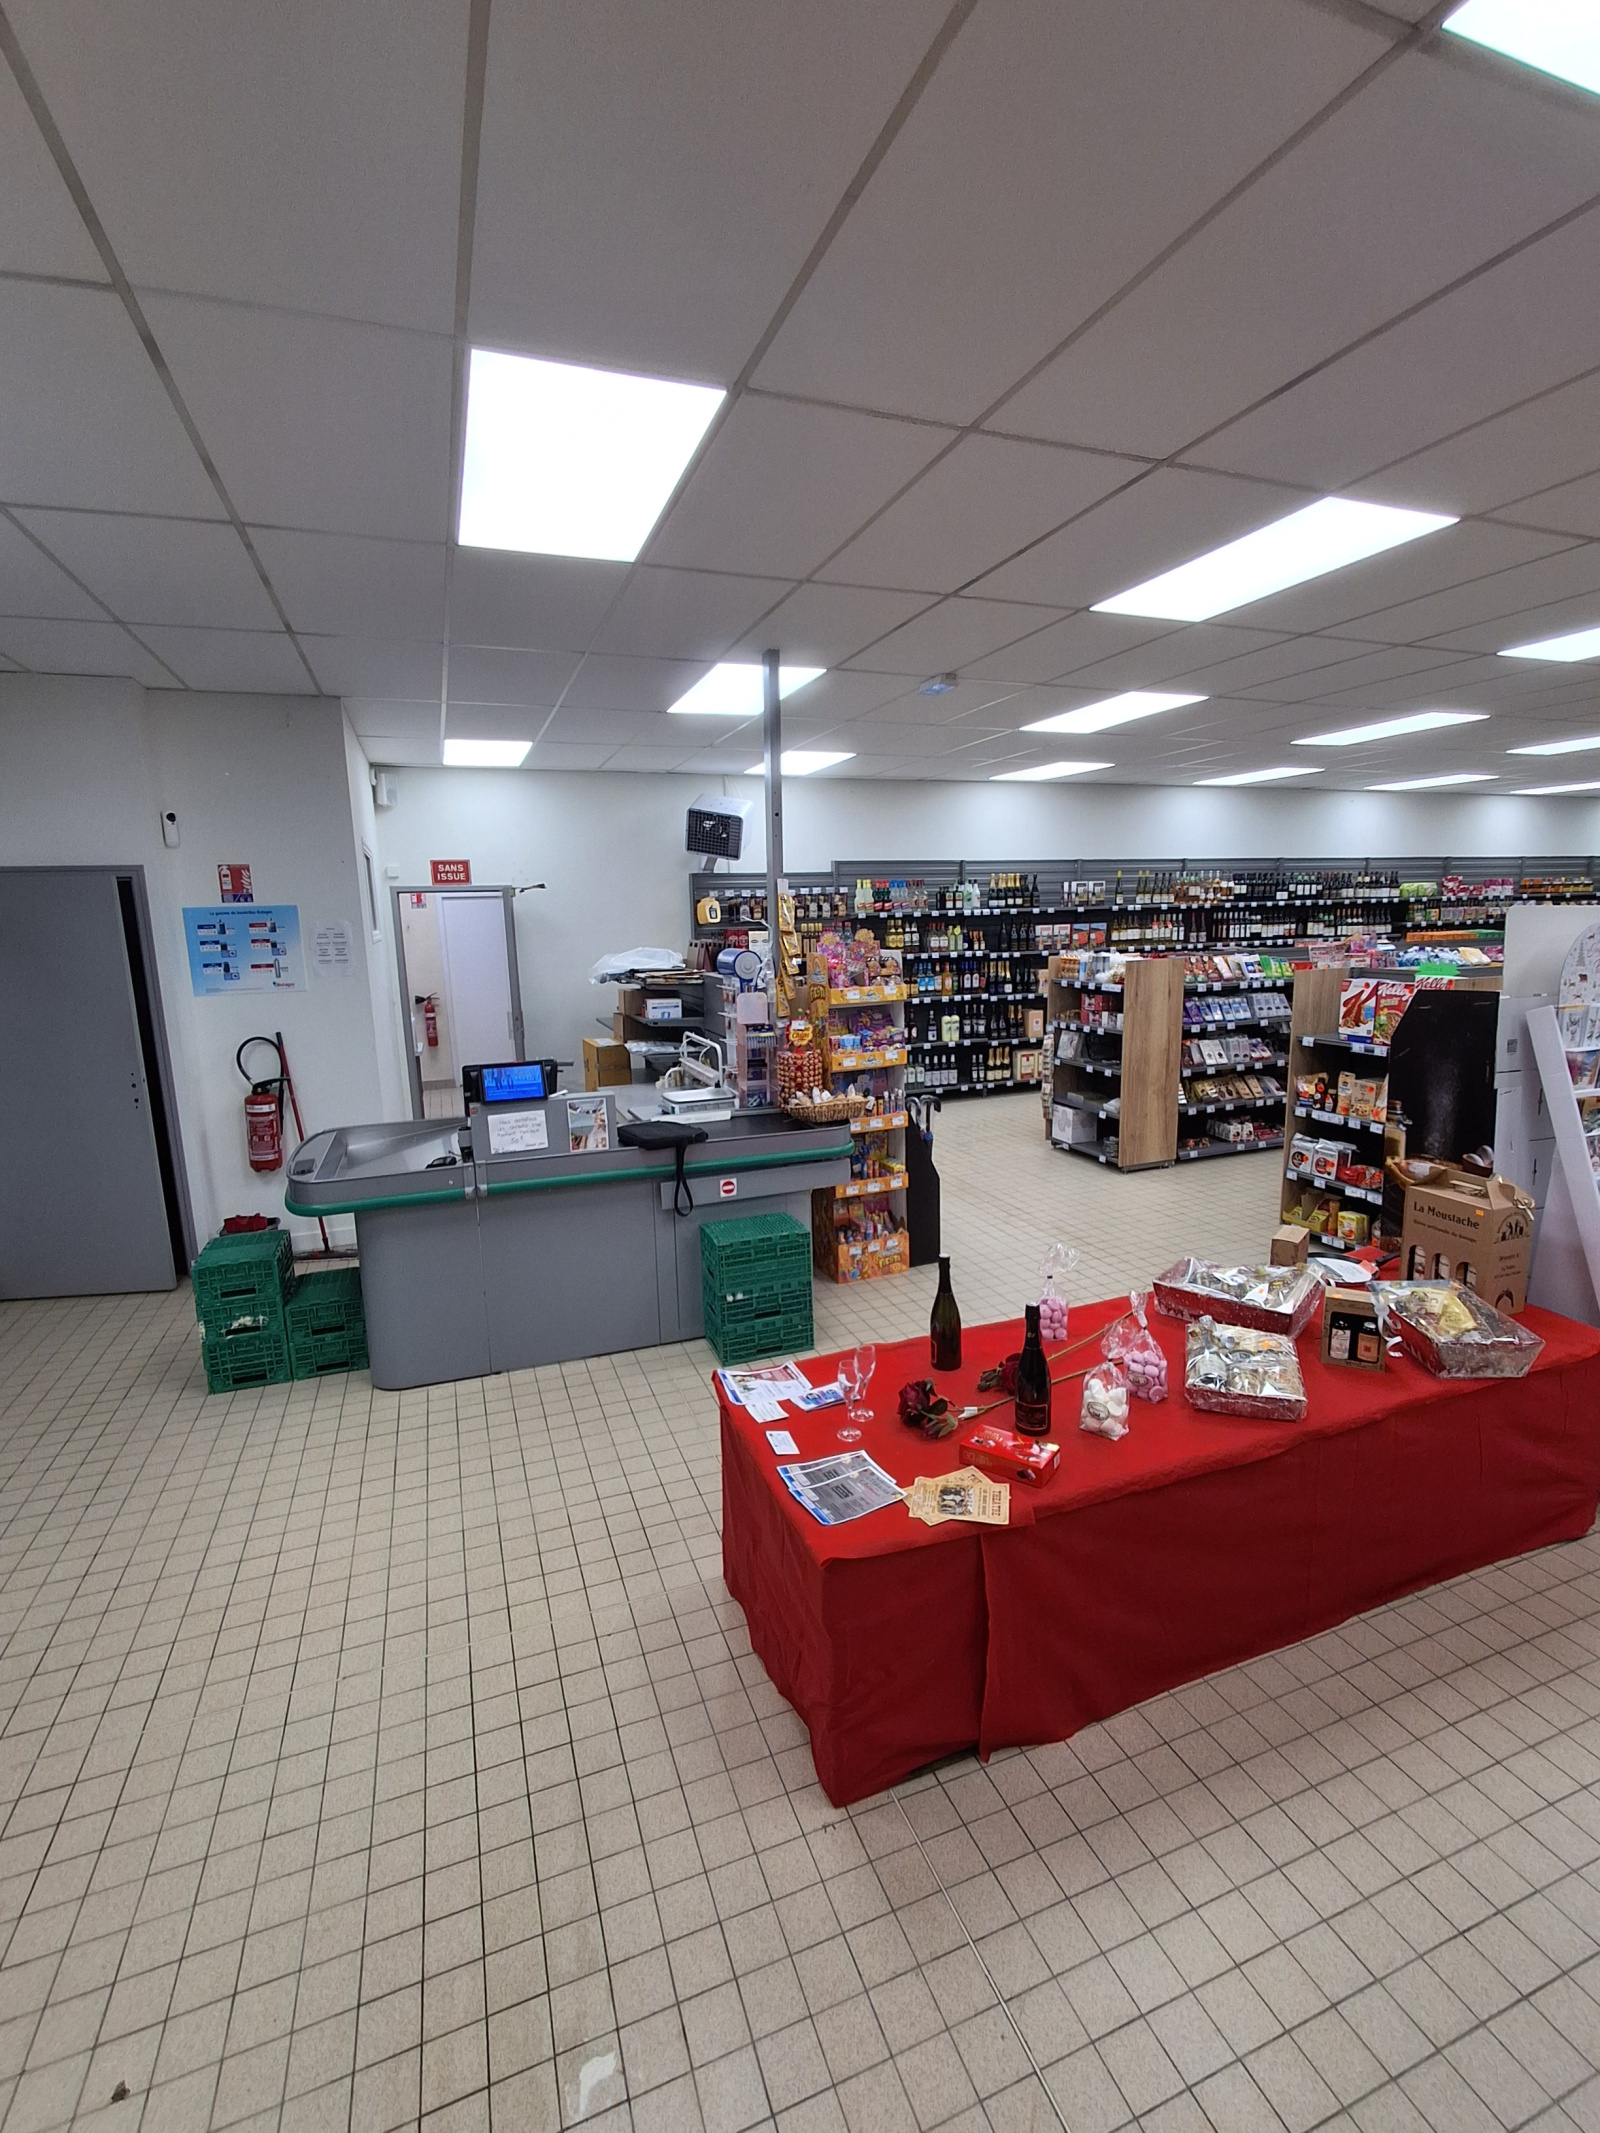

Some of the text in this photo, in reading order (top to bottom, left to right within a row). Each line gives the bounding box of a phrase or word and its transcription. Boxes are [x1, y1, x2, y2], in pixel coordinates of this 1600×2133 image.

[438, 864, 464, 872] SANS
[437, 872, 466, 881] ISSUE
[1414, 1201, 1425, 1213] La
[1427, 1205, 1480, 1230] Moustache
